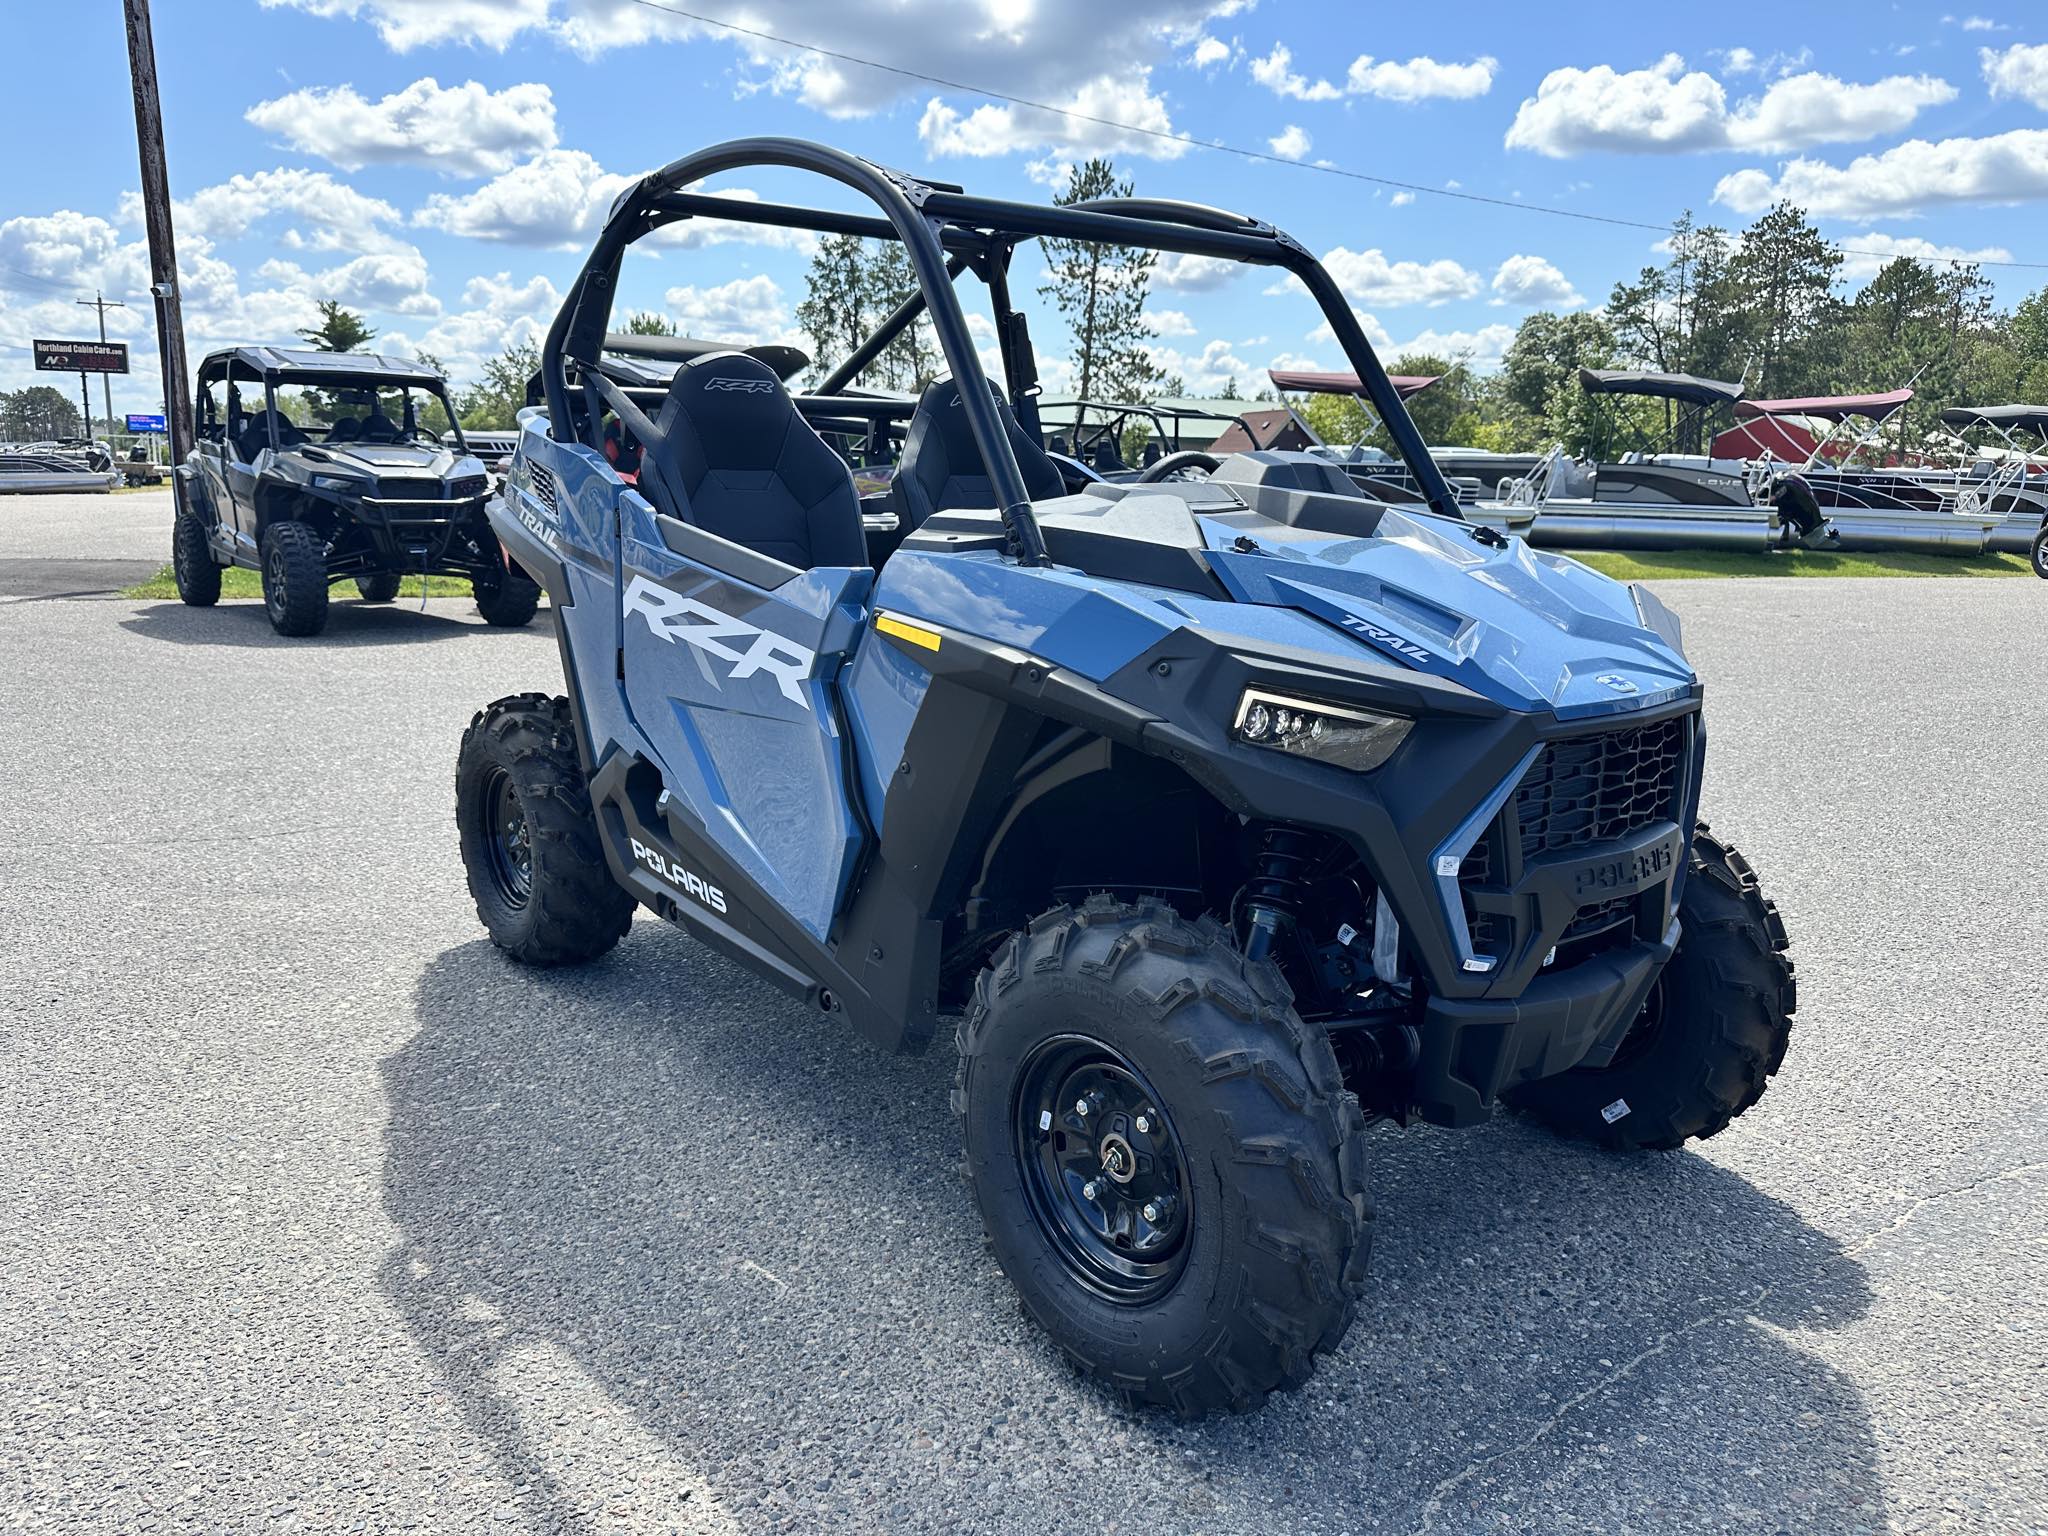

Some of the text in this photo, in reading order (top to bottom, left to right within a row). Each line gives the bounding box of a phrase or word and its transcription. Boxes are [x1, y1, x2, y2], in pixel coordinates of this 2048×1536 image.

[704, 377, 774, 393] RZR
[1697, 478, 1743, 487] LOWE
[519, 505, 558, 550] TRAIL
[623, 574, 816, 711] RZR
[1341, 614, 1430, 663] TRAIL
[630, 837, 728, 914] POLARIS
[1576, 842, 1671, 895] POLARIS
